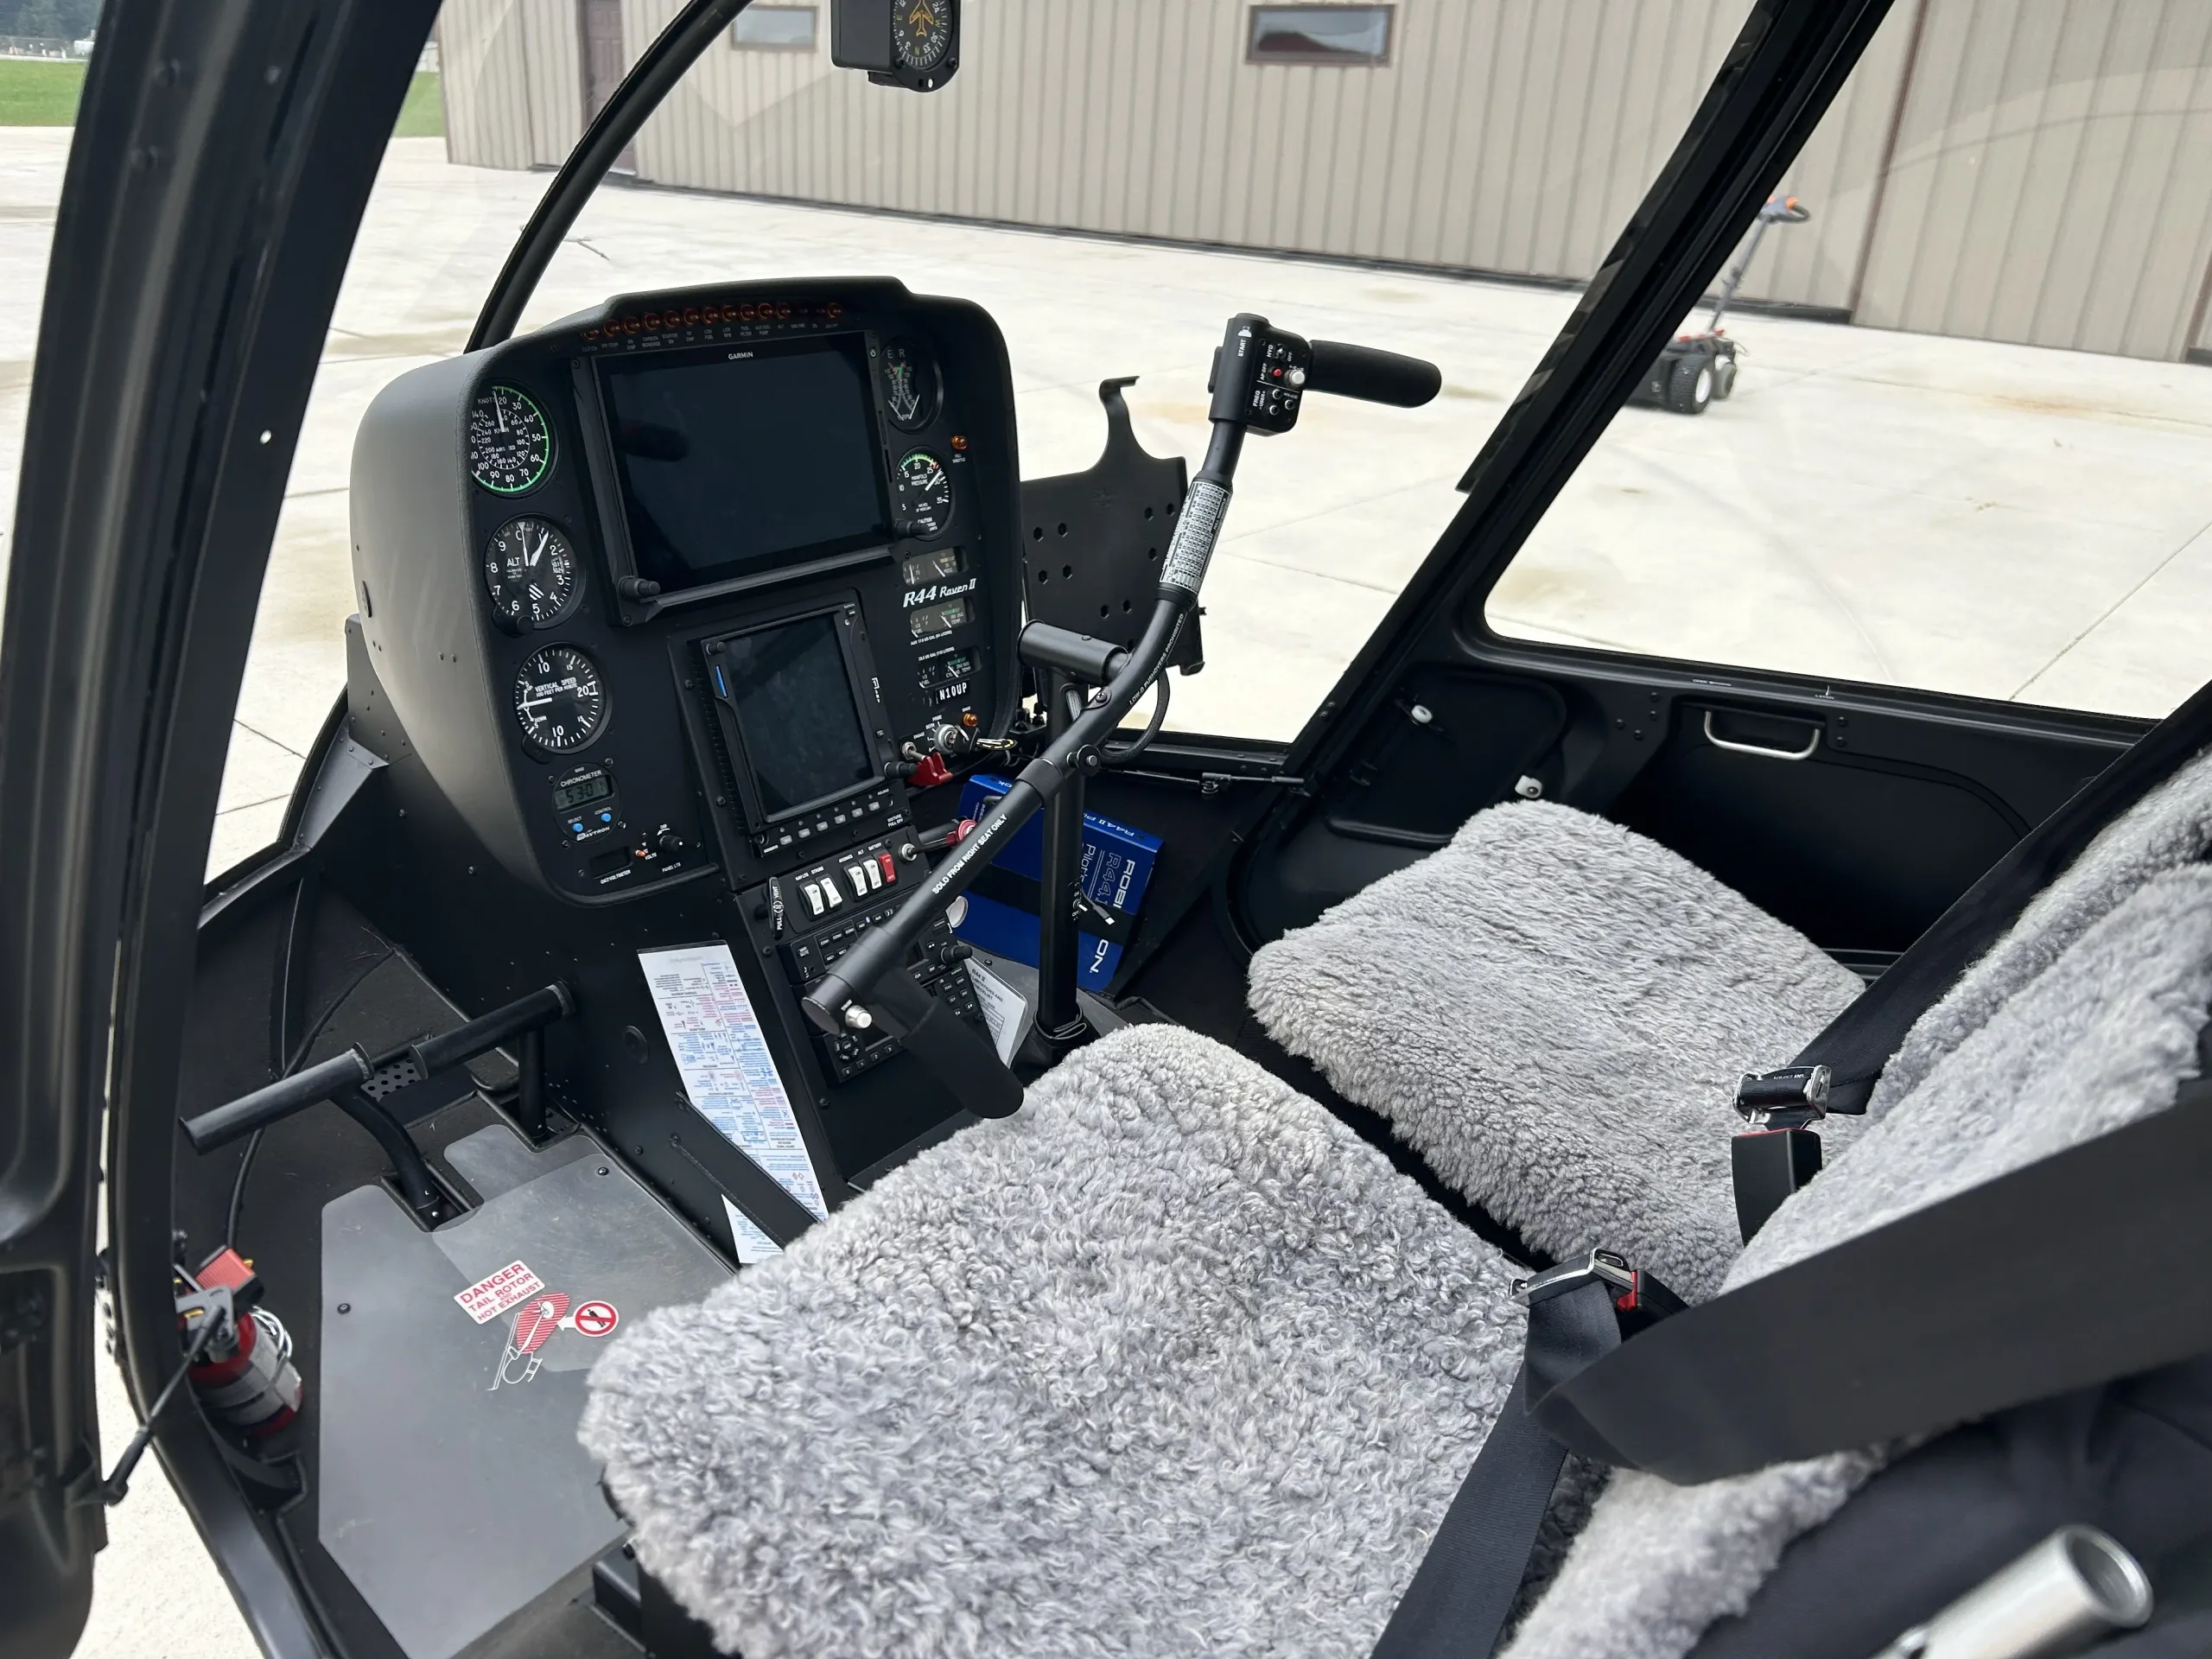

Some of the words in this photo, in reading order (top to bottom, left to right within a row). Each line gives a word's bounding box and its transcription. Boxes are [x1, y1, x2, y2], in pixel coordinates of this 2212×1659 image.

[887, 350, 893, 359] E
[899, 349, 906, 358] R
[499, 541, 505, 551] 9
[550, 545, 557, 555] 2
[507, 557, 519, 567] ALT
[491, 563, 498, 573] 8
[556, 575, 563, 585] 3
[494, 586, 501, 595] 7
[903, 586, 937, 607] R44
[939, 584, 968, 598] Raven
[550, 592, 556, 601] 4
[512, 601, 519, 610] 6
[532, 604, 540, 613] 5
[1144, 653, 1166, 688] PUSHOVERS
[1166, 613, 1184, 652] PROHIBITED
[538, 662, 550, 673] 10
[535, 682, 558, 692] VERTICAL
[561, 677, 576, 686] SPEED
[577, 686, 588, 697] 20
[939, 683, 967, 700] N10UP
[552, 726, 563, 737] 10
[561, 770, 601, 787] CHRONOMETER
[577, 826, 609, 841] DAVTRON
[1108, 823, 1134, 836] R44
[932, 877, 950, 893] SOLO
[947, 860, 964, 879] FROM
[962, 843, 980, 862] RIGHT
[977, 829, 994, 845] SEAT
[991, 814, 1007, 830] ONLY
[972, 969, 981, 978] R44
[972, 976, 995, 995] LIMITATIONS
[460, 1264, 524, 1303] DANGER
[468, 1297, 494, 1312] TAIL
[495, 1273, 533, 1297] ROTOR
[478, 1306, 498, 1320] HOT
[499, 1281, 541, 1308] EXHAUST
